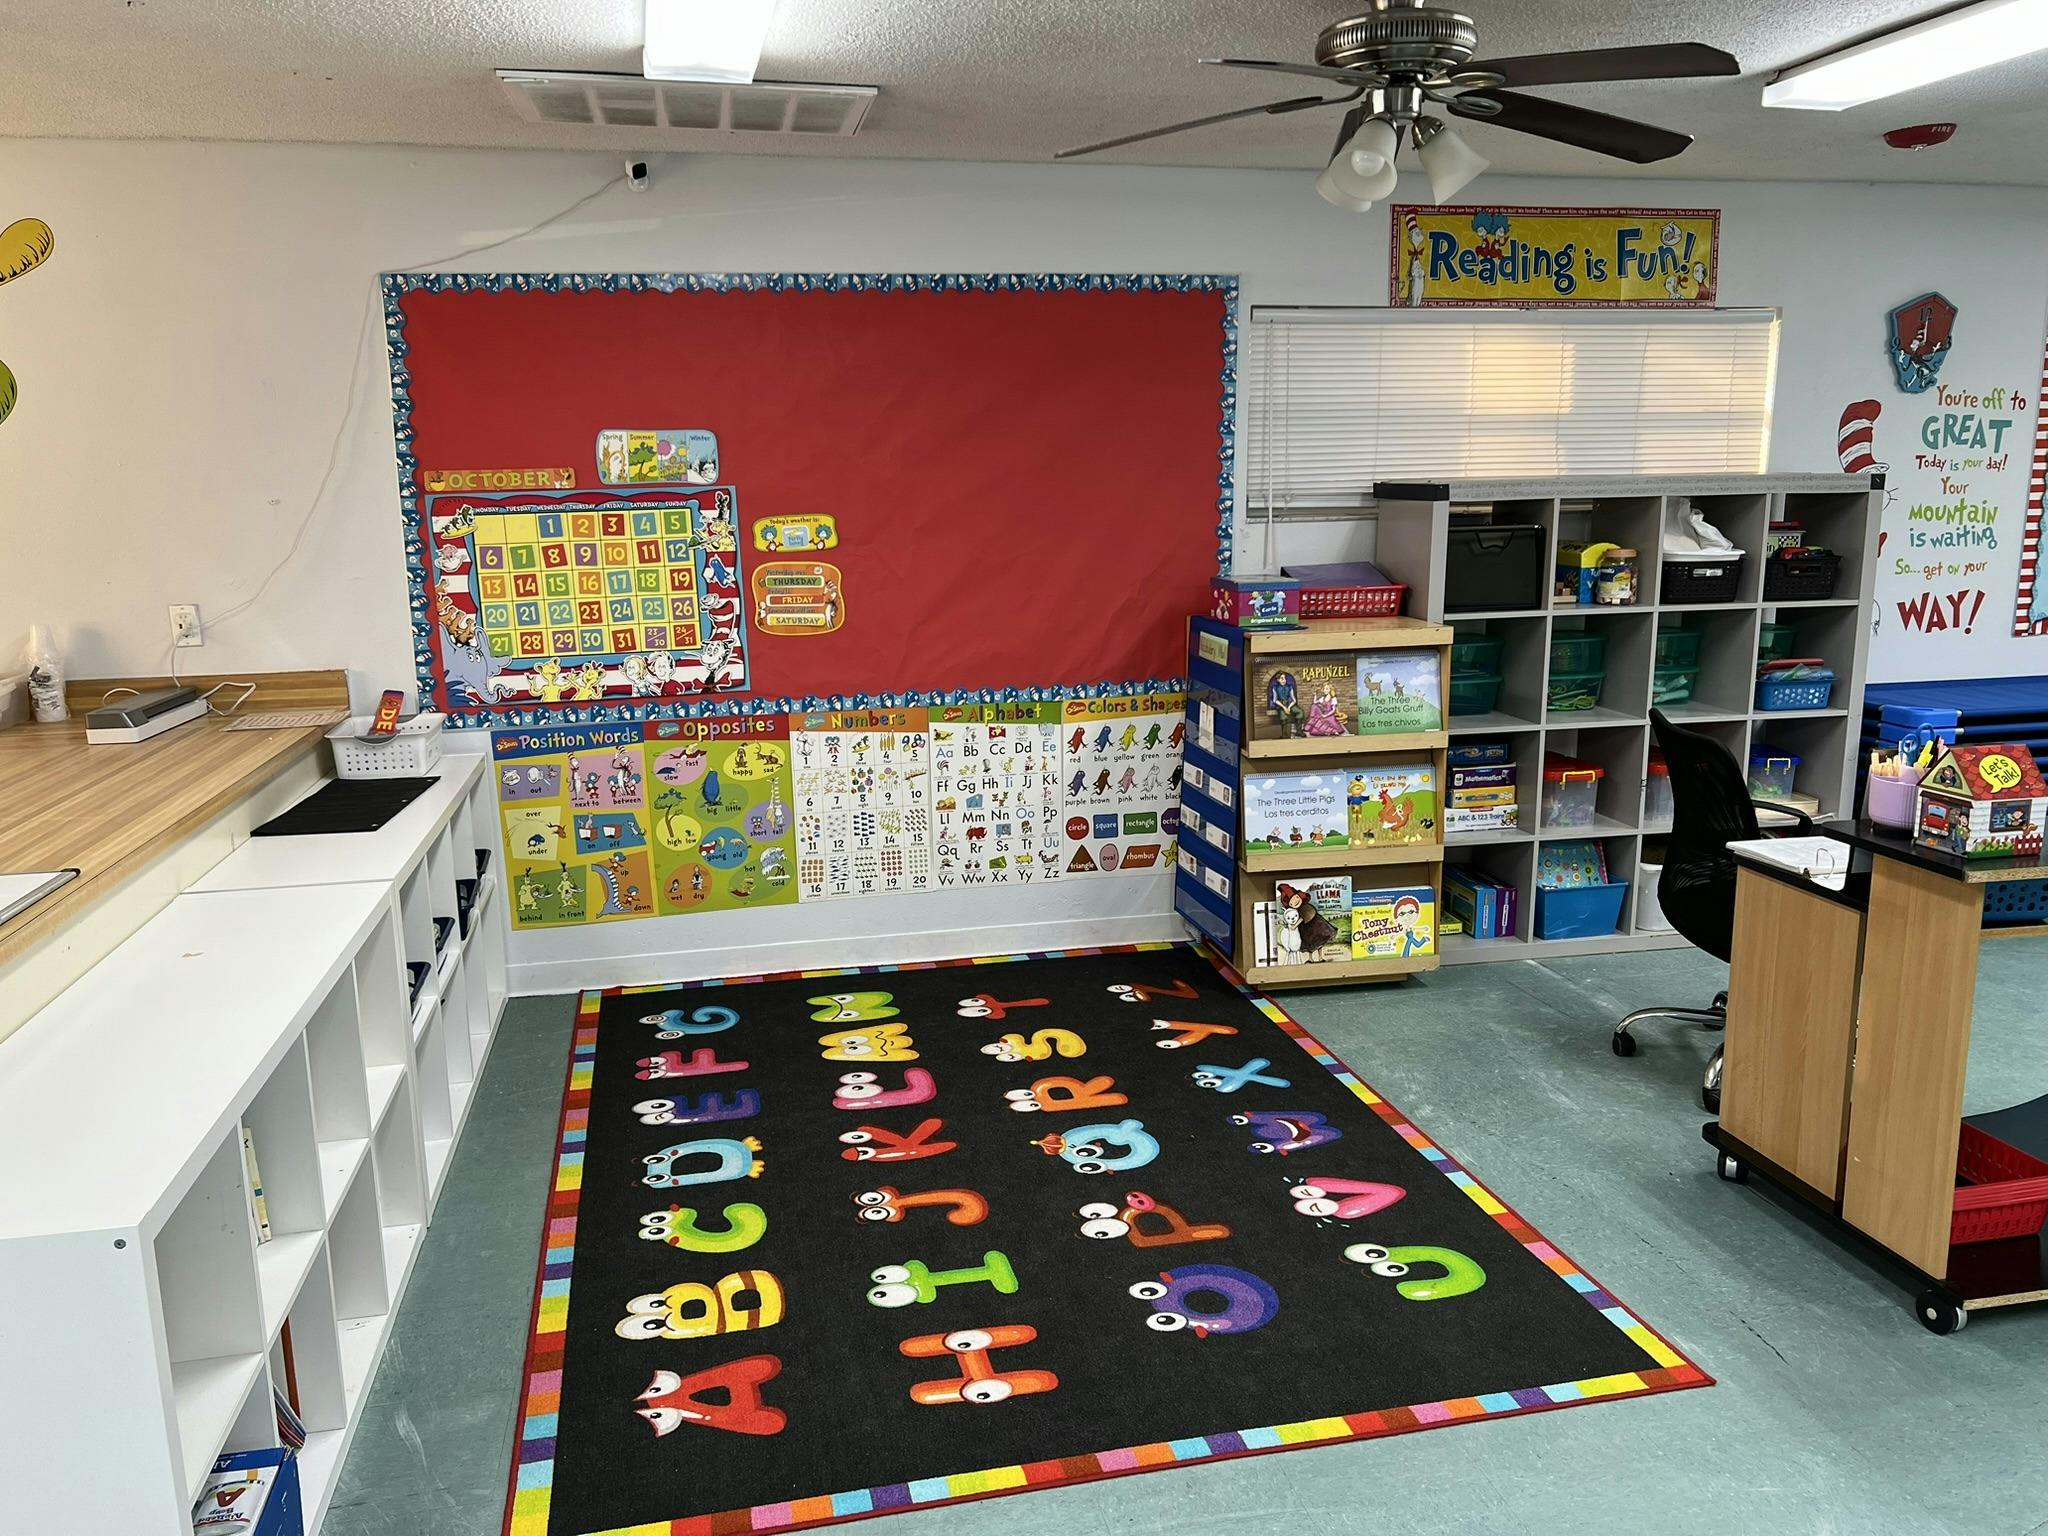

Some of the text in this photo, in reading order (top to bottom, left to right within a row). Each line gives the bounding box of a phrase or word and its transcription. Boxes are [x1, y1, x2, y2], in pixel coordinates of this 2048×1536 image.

[1428, 227, 1695, 295] Reading is Fun!
[1920, 308, 1933, 320] 12
[1937, 384, 2026, 411] You're off to
[602, 434, 623, 442] Spring
[1921, 414, 2012, 453] GREAT
[1916, 454, 2008, 472] Today is your day!
[449, 470, 551, 487] OCTOBER
[1941, 477, 1969, 496] Your
[608, 514, 680, 531] 3 5
[1910, 528, 1926, 547] is
[606, 542, 686, 562] 10 12
[1895, 559, 1920, 575] So...
[1924, 562, 1943, 580] get
[1964, 562, 1987, 576] your
[517, 572, 690, 593] 14 19
[773, 577, 817, 585] THURSDAY
[782, 596, 813, 604] FRIDAY
[581, 600, 692, 618] 23 26
[1896, 589, 1985, 635] WAY!
[523, 635, 542, 649] 28
[1302, 664, 1350, 681] RAPUNZEL
[1388, 696, 1410, 704] Three
[1087, 699, 1127, 714] Colors
[1130, 700, 1139, 712] &
[1359, 704, 1423, 716] Billy Goats Gruff
[968, 703, 1042, 726] Alphabet
[831, 712, 907, 729] Numbers
[1394, 718, 1421, 726] chivos
[683, 717, 775, 742] Opposites
[519, 733, 586, 749] Position
[590, 726, 639, 745] Words
[936, 747, 953, 759] Aa
[963, 745, 979, 757] Bb
[1015, 741, 1032, 754] Dd
[912, 750, 918, 758] 5
[1114, 754, 1135, 762] yellow
[1141, 753, 1160, 762] green
[1166, 751, 1184, 761] orang
[686, 759, 699, 767] fast
[1981, 757, 2009, 776] Let's
[732, 768, 753, 777] happy
[763, 766, 775, 774] sad
[1993, 769, 2020, 786] Talk!
[530, 786, 542, 794] out
[911, 790, 922, 798] 10
[574, 800, 588, 808] next
[613, 796, 641, 804] between
[1065, 798, 1086, 807] purple
[1118, 795, 1132, 804] pink
[1258, 795, 1336, 807] The Three Little Pigs
[706, 806, 718, 816] big
[725, 804, 742, 812] little
[1265, 808, 1329, 818] Los tres cerditos
[962, 812, 985, 823] Mm
[1162, 817, 1180, 827] octag
[1068, 823, 1086, 831] circle
[1095, 822, 1116, 833] square
[1125, 818, 1155, 829] rectangle
[750, 828, 767, 837] short
[772, 828, 784, 836] tall
[609, 840, 620, 848] off
[667, 838, 682, 846] high
[860, 838, 869, 846] 13
[528, 848, 548, 856] under
[706, 852, 727, 861] young
[1127, 851, 1155, 860] rhombus
[1102, 854, 1116, 862] oval
[1070, 861, 1095, 871] triangle
[962, 873, 985, 884] Ww
[1044, 867, 1059, 879] Zz
[771, 879, 786, 887] cold
[913, 876, 926, 884] 20
[811, 885, 821, 893] 16
[1316, 890, 1340, 899] LLAMA
[693, 892, 705, 900] dry
[634, 904, 652, 912] down
[519, 912, 543, 922] behind
[566, 910, 584, 919] front
[1362, 917, 1389, 929] Tony
[1353, 923, 1403, 941] Chestnut
[639, 1005, 740, 1040] G
[981, 1028, 1087, 1062] S
[635, 1047, 749, 1081] F
[1190, 1058, 1291, 1093] X
[641, 1135, 765, 1188] D
[1344, 1242, 1486, 1301] U
[615, 1270, 785, 1340] B
[1129, 1263, 1279, 1338] O
[900, 1325, 1059, 1405] H
[633, 1353, 787, 1438] A
